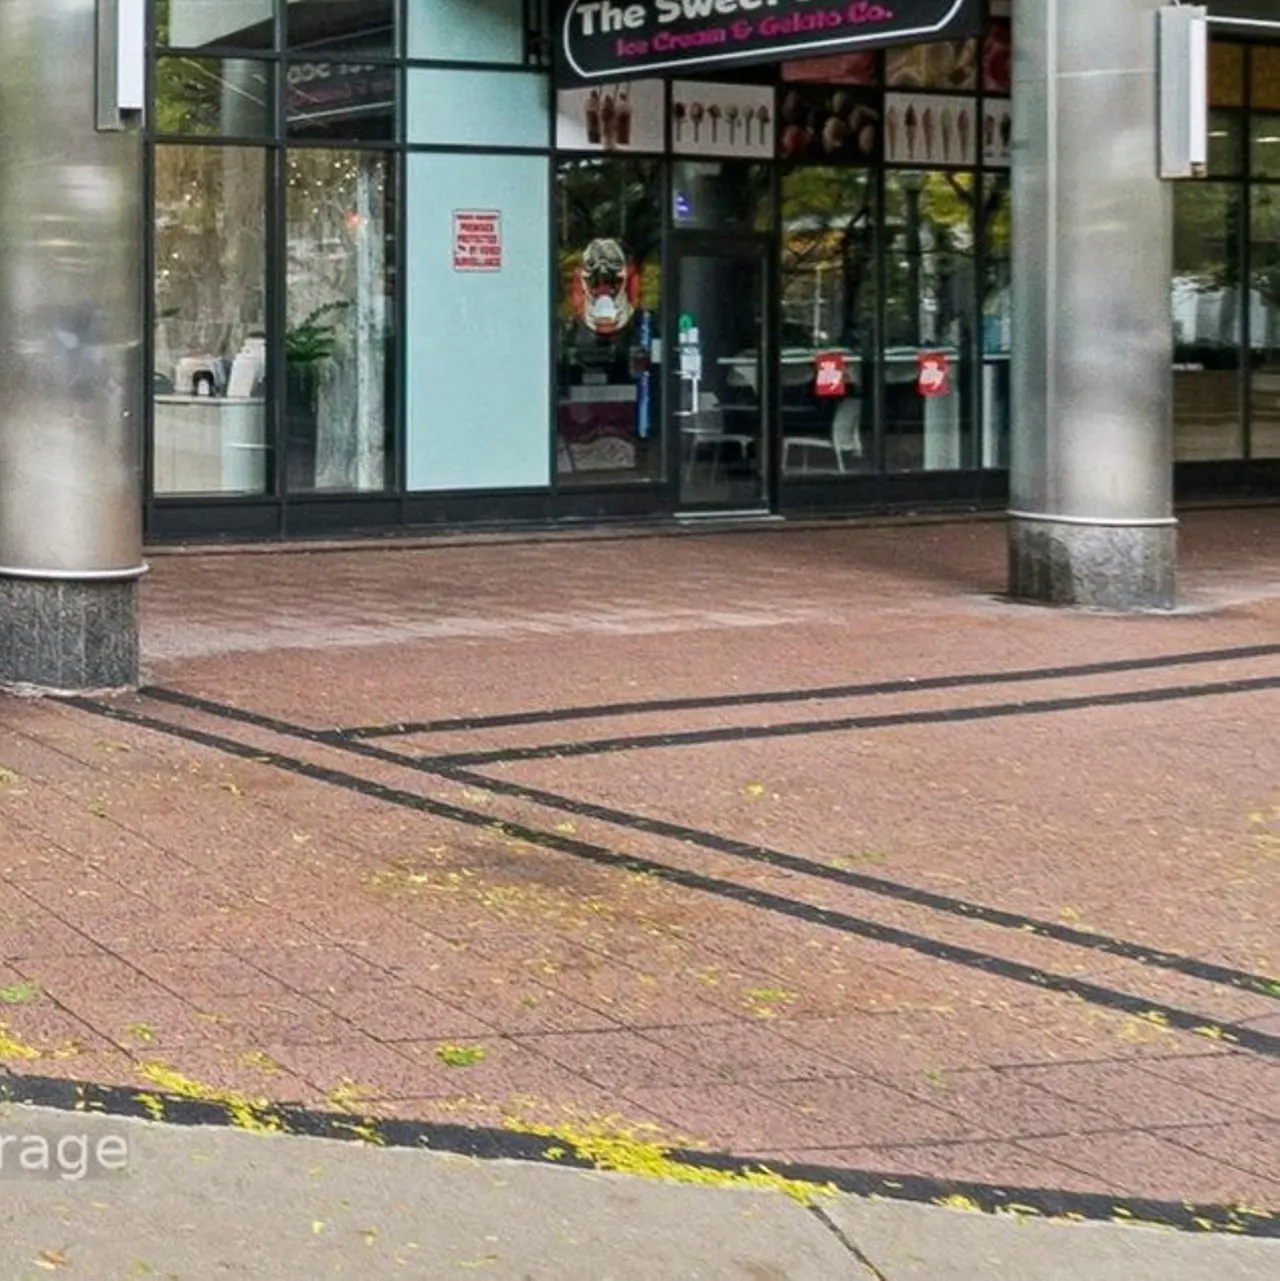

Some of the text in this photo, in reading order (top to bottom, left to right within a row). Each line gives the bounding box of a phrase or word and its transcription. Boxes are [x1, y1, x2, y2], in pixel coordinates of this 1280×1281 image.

[576, 0, 646, 35] The
[616, 39, 648, 57] Ice
[652, 28, 726, 51] Cream
[758, 11, 842, 36] Gelato
[846, 0, 893, 23] Co.
